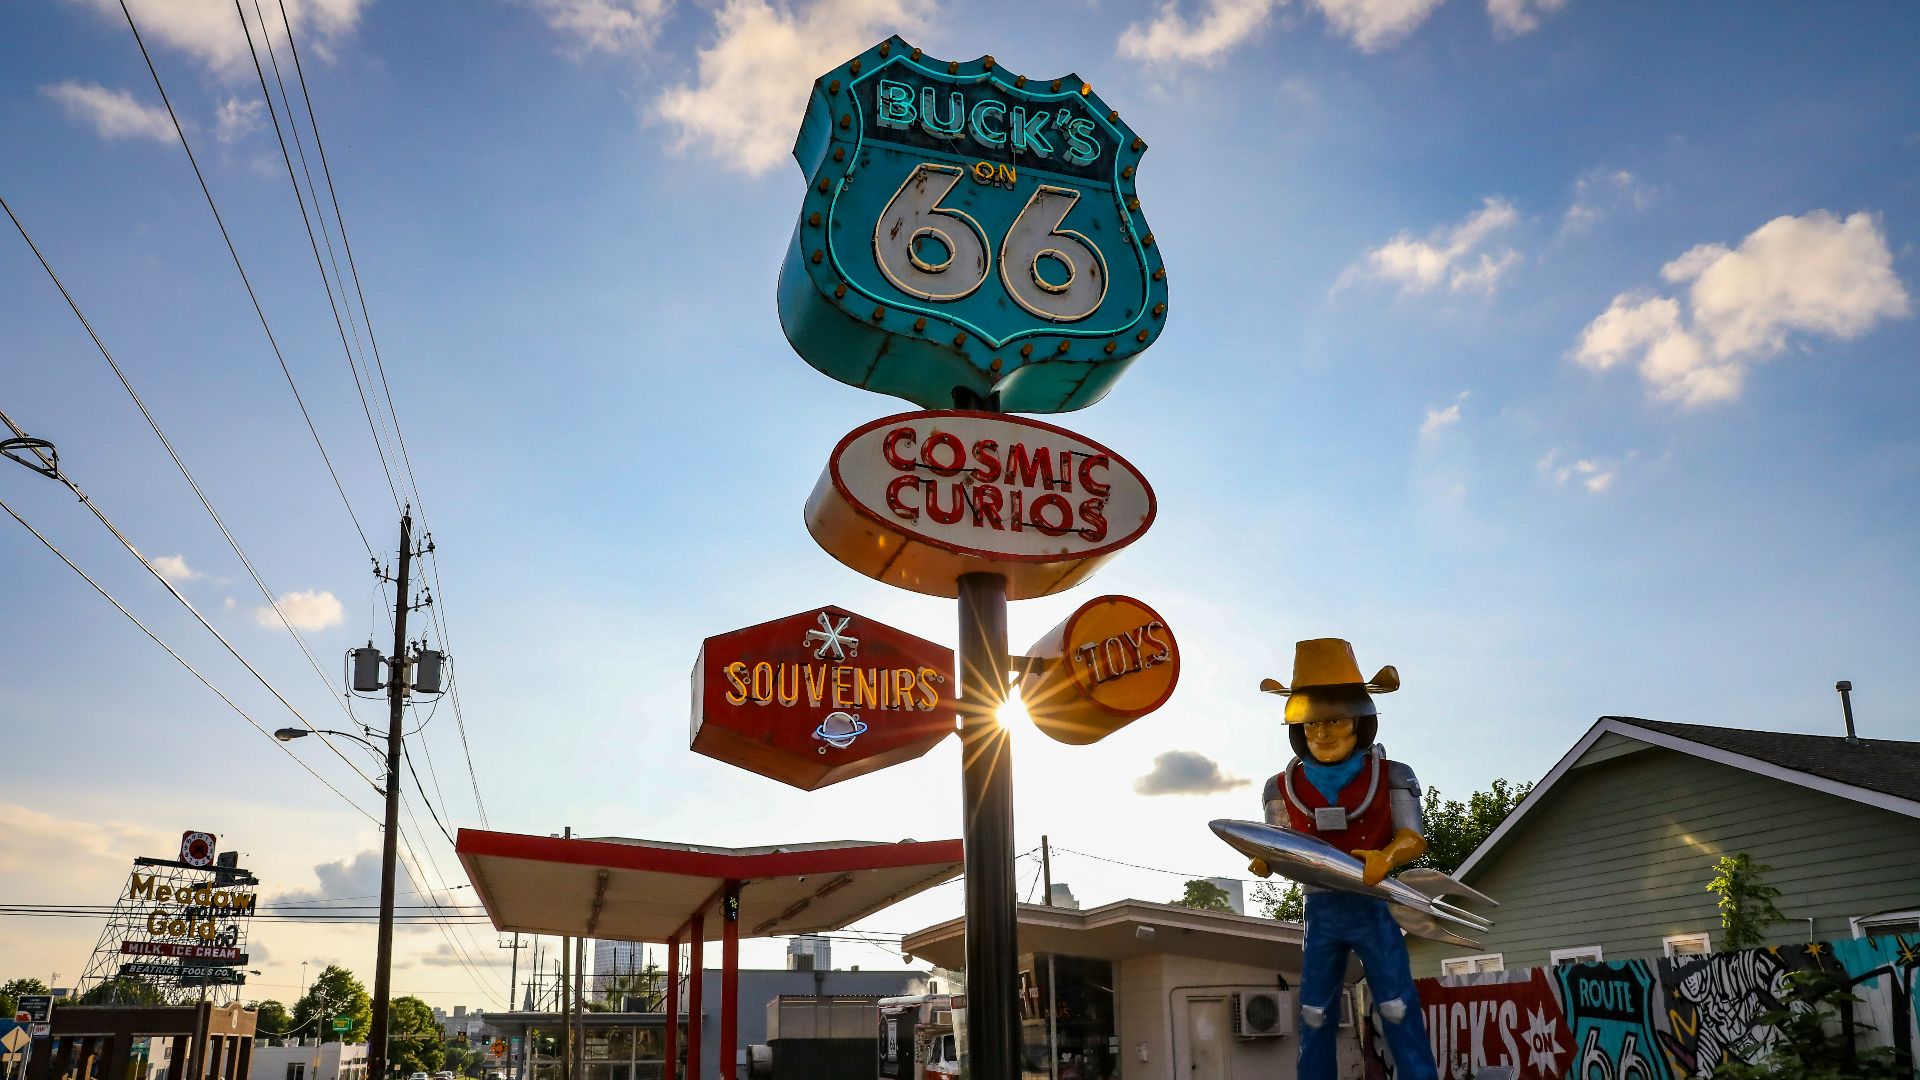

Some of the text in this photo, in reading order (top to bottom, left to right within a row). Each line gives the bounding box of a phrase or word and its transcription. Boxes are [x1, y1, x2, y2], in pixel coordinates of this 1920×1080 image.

[877, 79, 1101, 166] BUCK'S
[971, 161, 1017, 191] ON
[874, 162, 1109, 322] 66
[882, 427, 1111, 497] COSMIC
[885, 475, 1109, 542] CURIOS
[1075, 621, 1171, 688] TOYS
[724, 660, 944, 712] SOUVENIRS
[130, 873, 251, 909] Meadow
[147, 910, 216, 941] Gold
[129, 965, 179, 975] BEATRICE
[172, 946, 192, 956] ICE
[196, 947, 236, 959] CREAM
[1579, 978, 1634, 1013] ROUTE
[1422, 1000, 1521, 1080] UCK'S
[1532, 1032, 1553, 1054] ON
